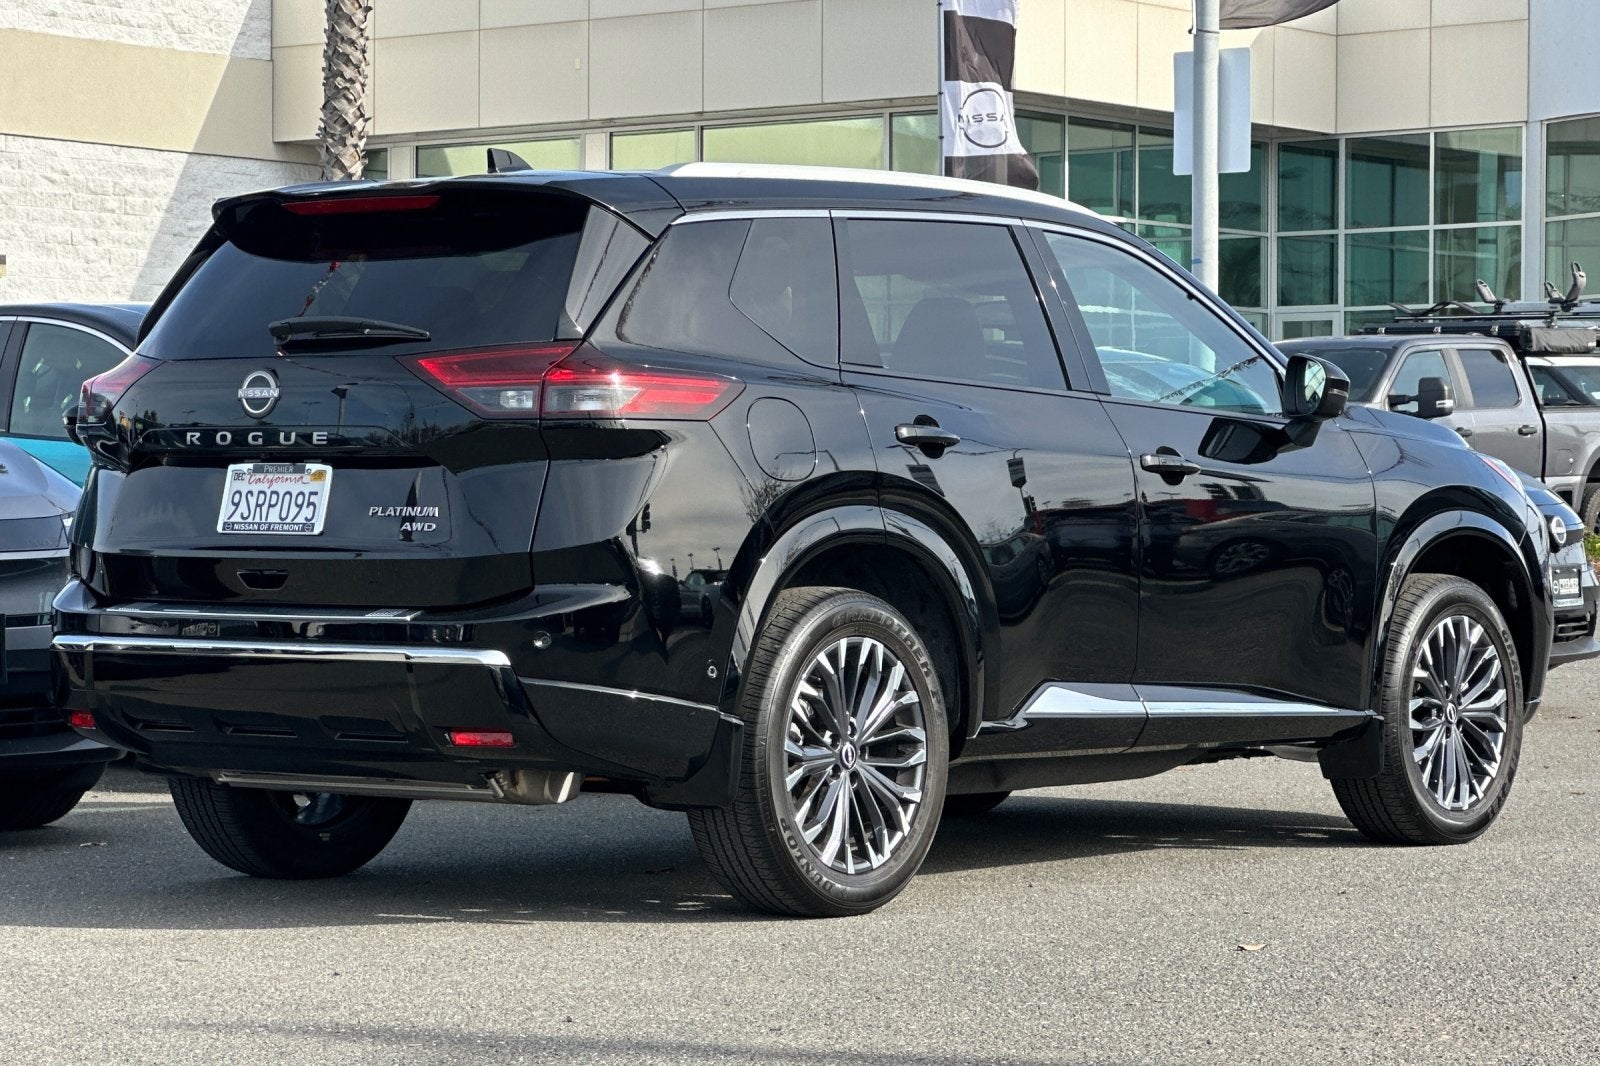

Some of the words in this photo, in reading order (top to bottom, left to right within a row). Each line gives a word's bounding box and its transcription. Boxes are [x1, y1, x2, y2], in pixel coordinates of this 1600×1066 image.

[957, 112, 1004, 123] NISSA
[238, 388, 279, 398] NISSAN
[186, 431, 328, 446] ROGUE
[263, 465, 294, 473] PREMIER
[233, 472, 246, 481] DEC
[247, 473, 310, 489] California
[226, 490, 319, 522] 9SRP095
[368, 506, 439, 517] PLATINUM
[233, 523, 258, 531] NISSAN
[260, 523, 269, 531] OF
[270, 523, 302, 531] FREMONT
[400, 522, 436, 532] AWD
[780, 817, 834, 893] DUNLOP
